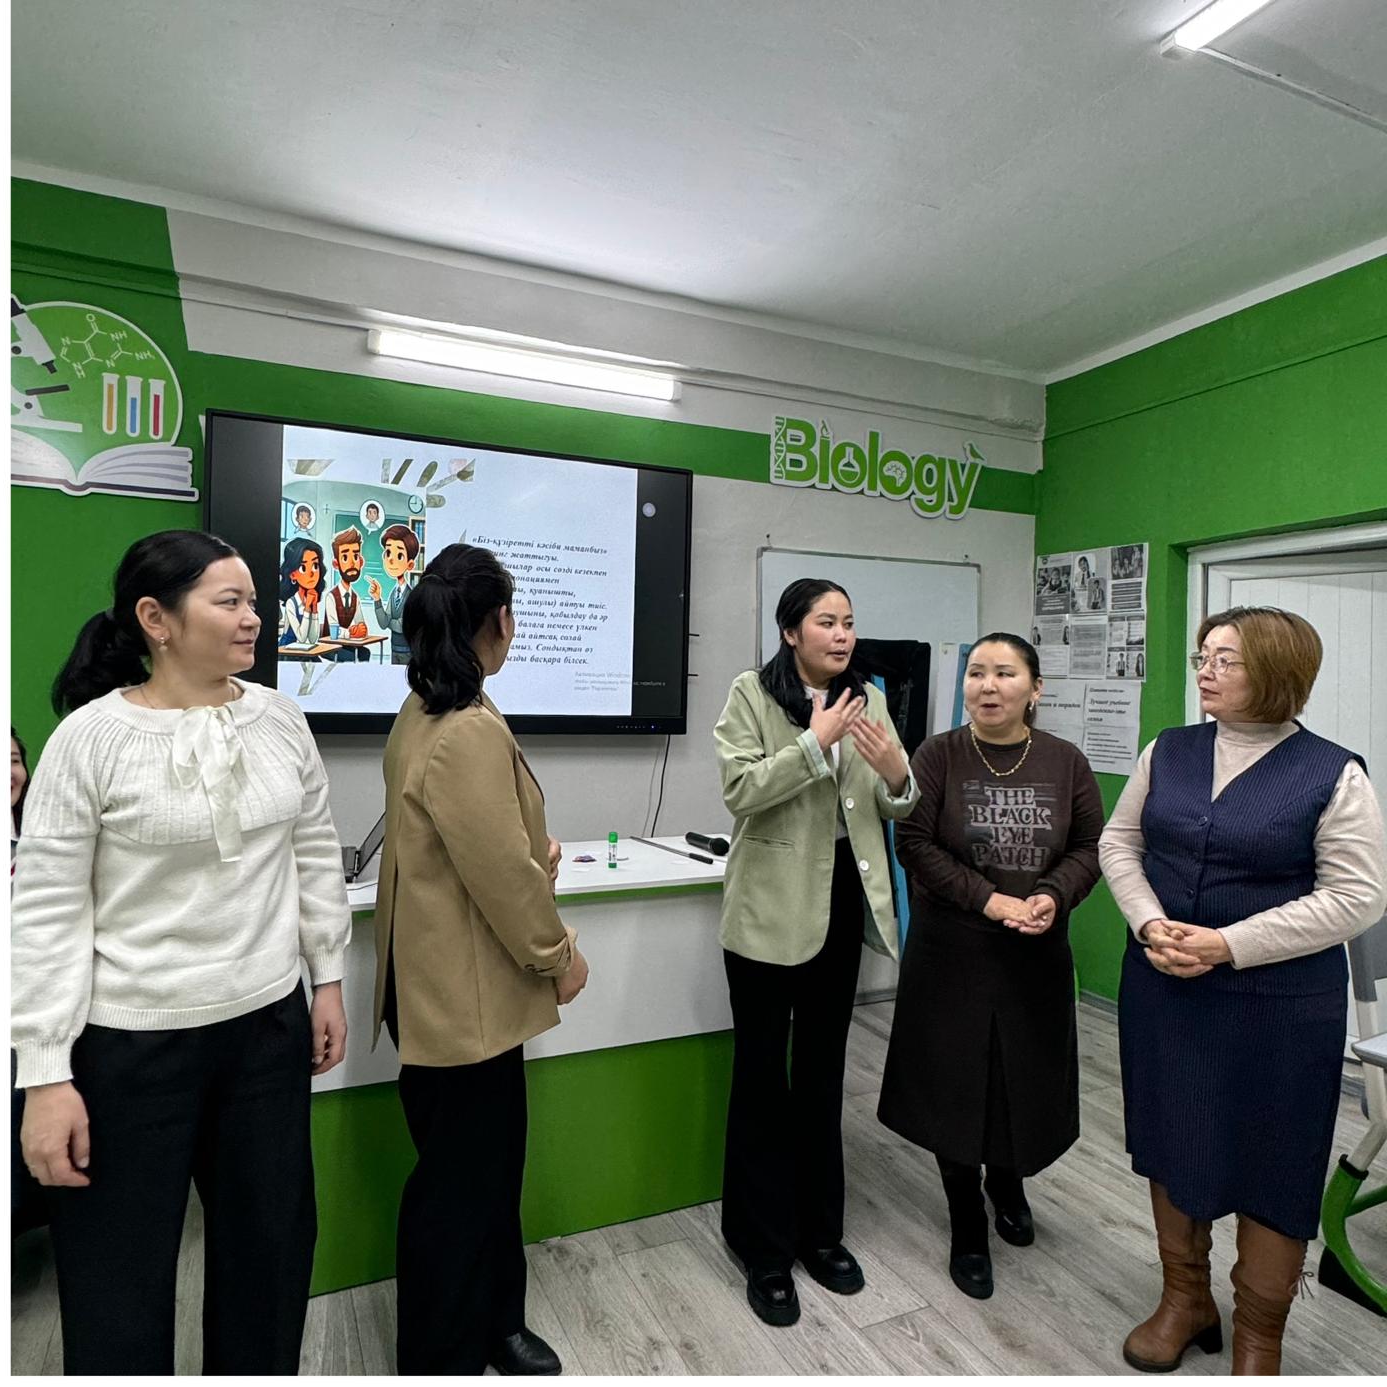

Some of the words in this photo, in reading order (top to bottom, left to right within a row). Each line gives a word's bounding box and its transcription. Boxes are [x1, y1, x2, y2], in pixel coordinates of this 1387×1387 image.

[774, 415, 980, 516] Biology
[985, 788, 1035, 806] THE
[971, 806, 1050, 826] BLACK
[992, 826, 1034, 845] EYE
[974, 845, 1047, 868] PATCH
